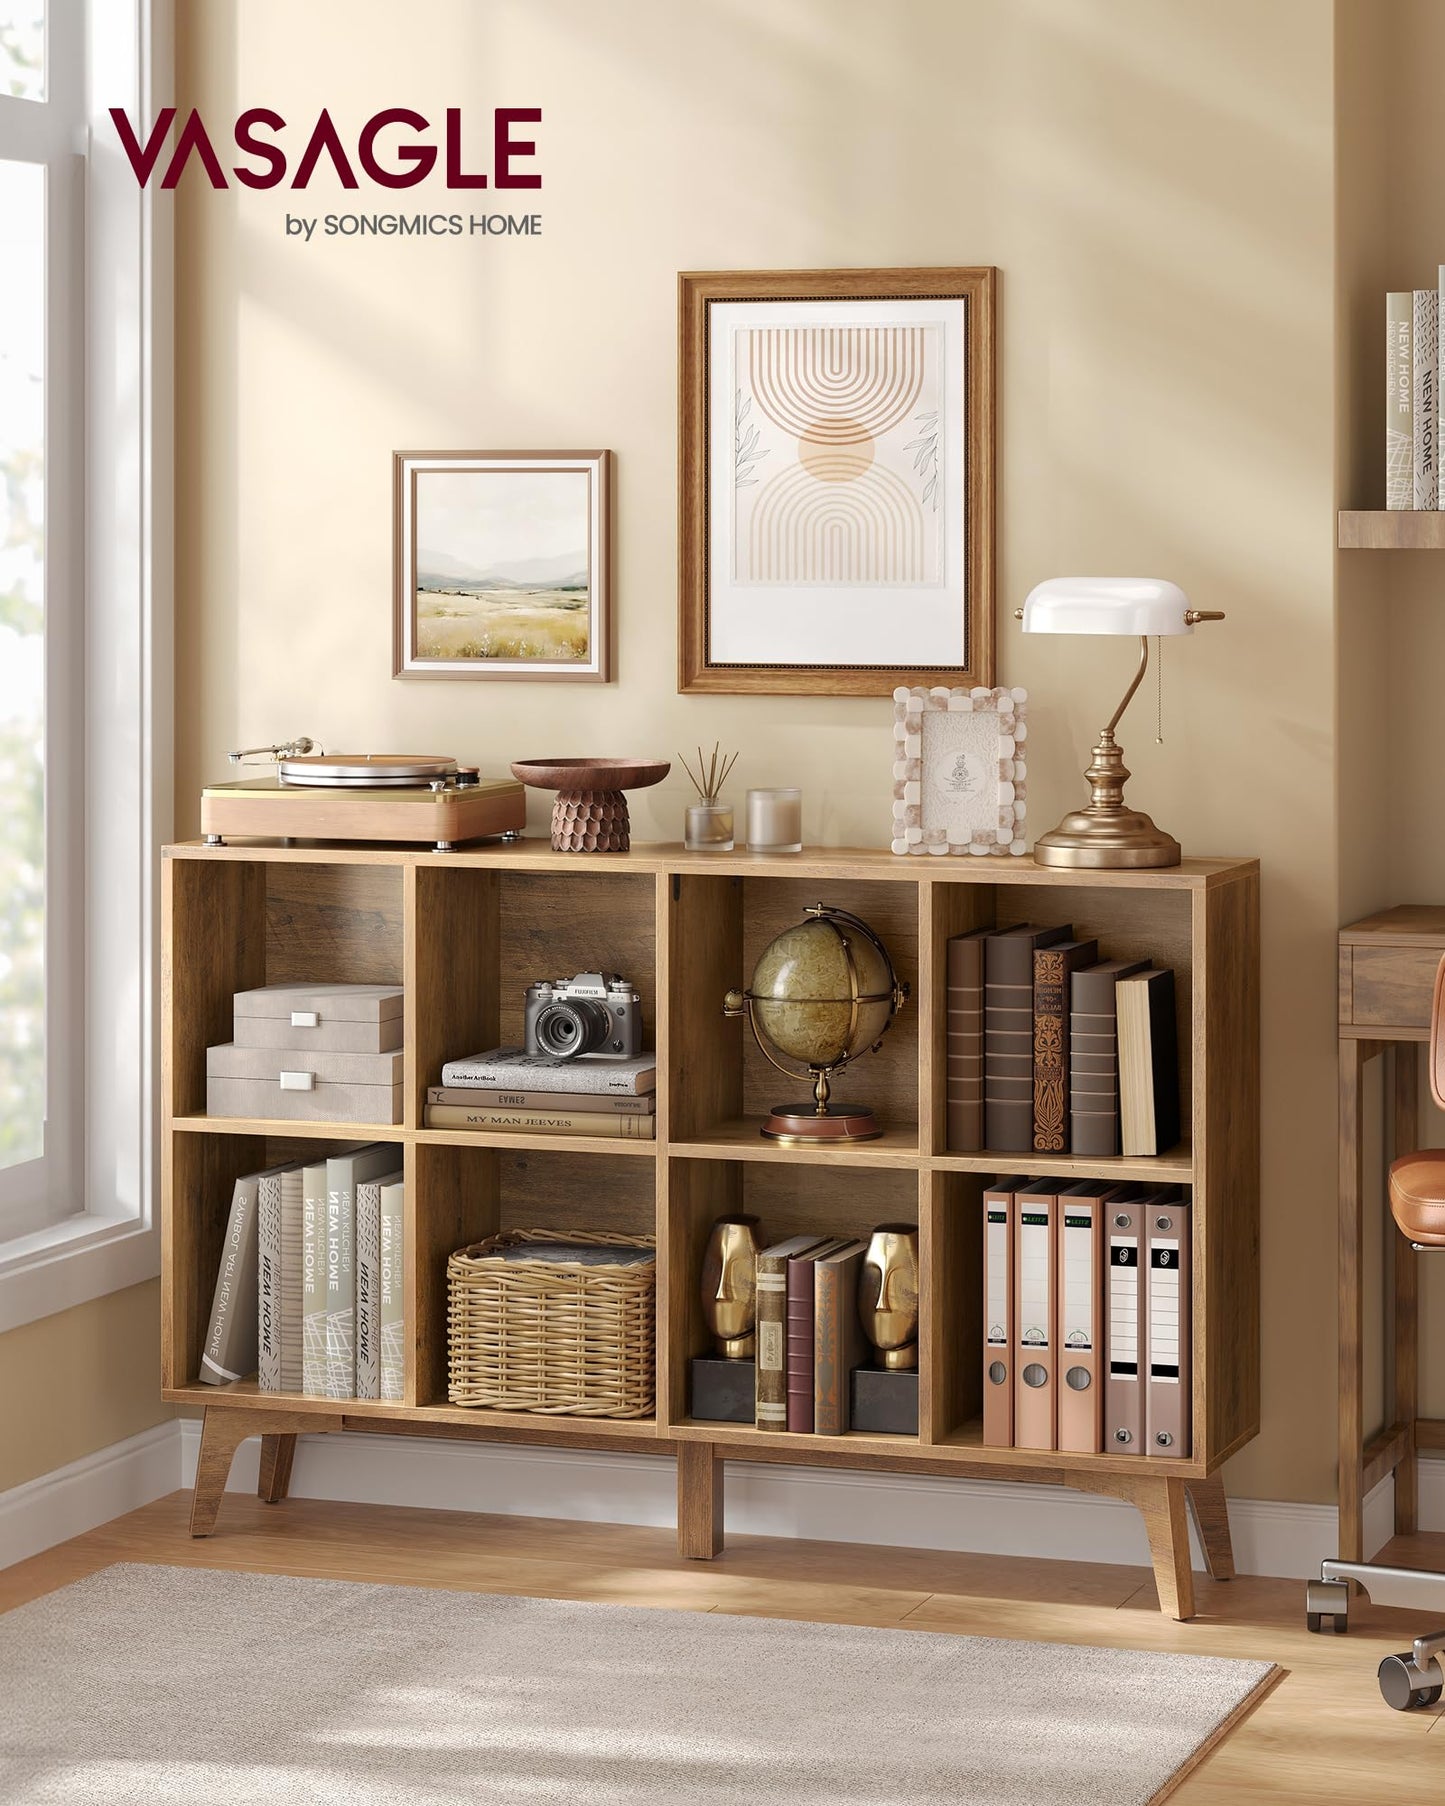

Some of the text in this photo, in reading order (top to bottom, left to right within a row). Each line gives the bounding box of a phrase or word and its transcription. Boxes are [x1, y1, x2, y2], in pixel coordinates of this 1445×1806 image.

[1399, 321, 1409, 413] NEW HOME
[1422, 370, 1432, 475] NEW HOME
[490, 1117, 521, 1125] MAN
[524, 1117, 572, 1127] JEEVES
